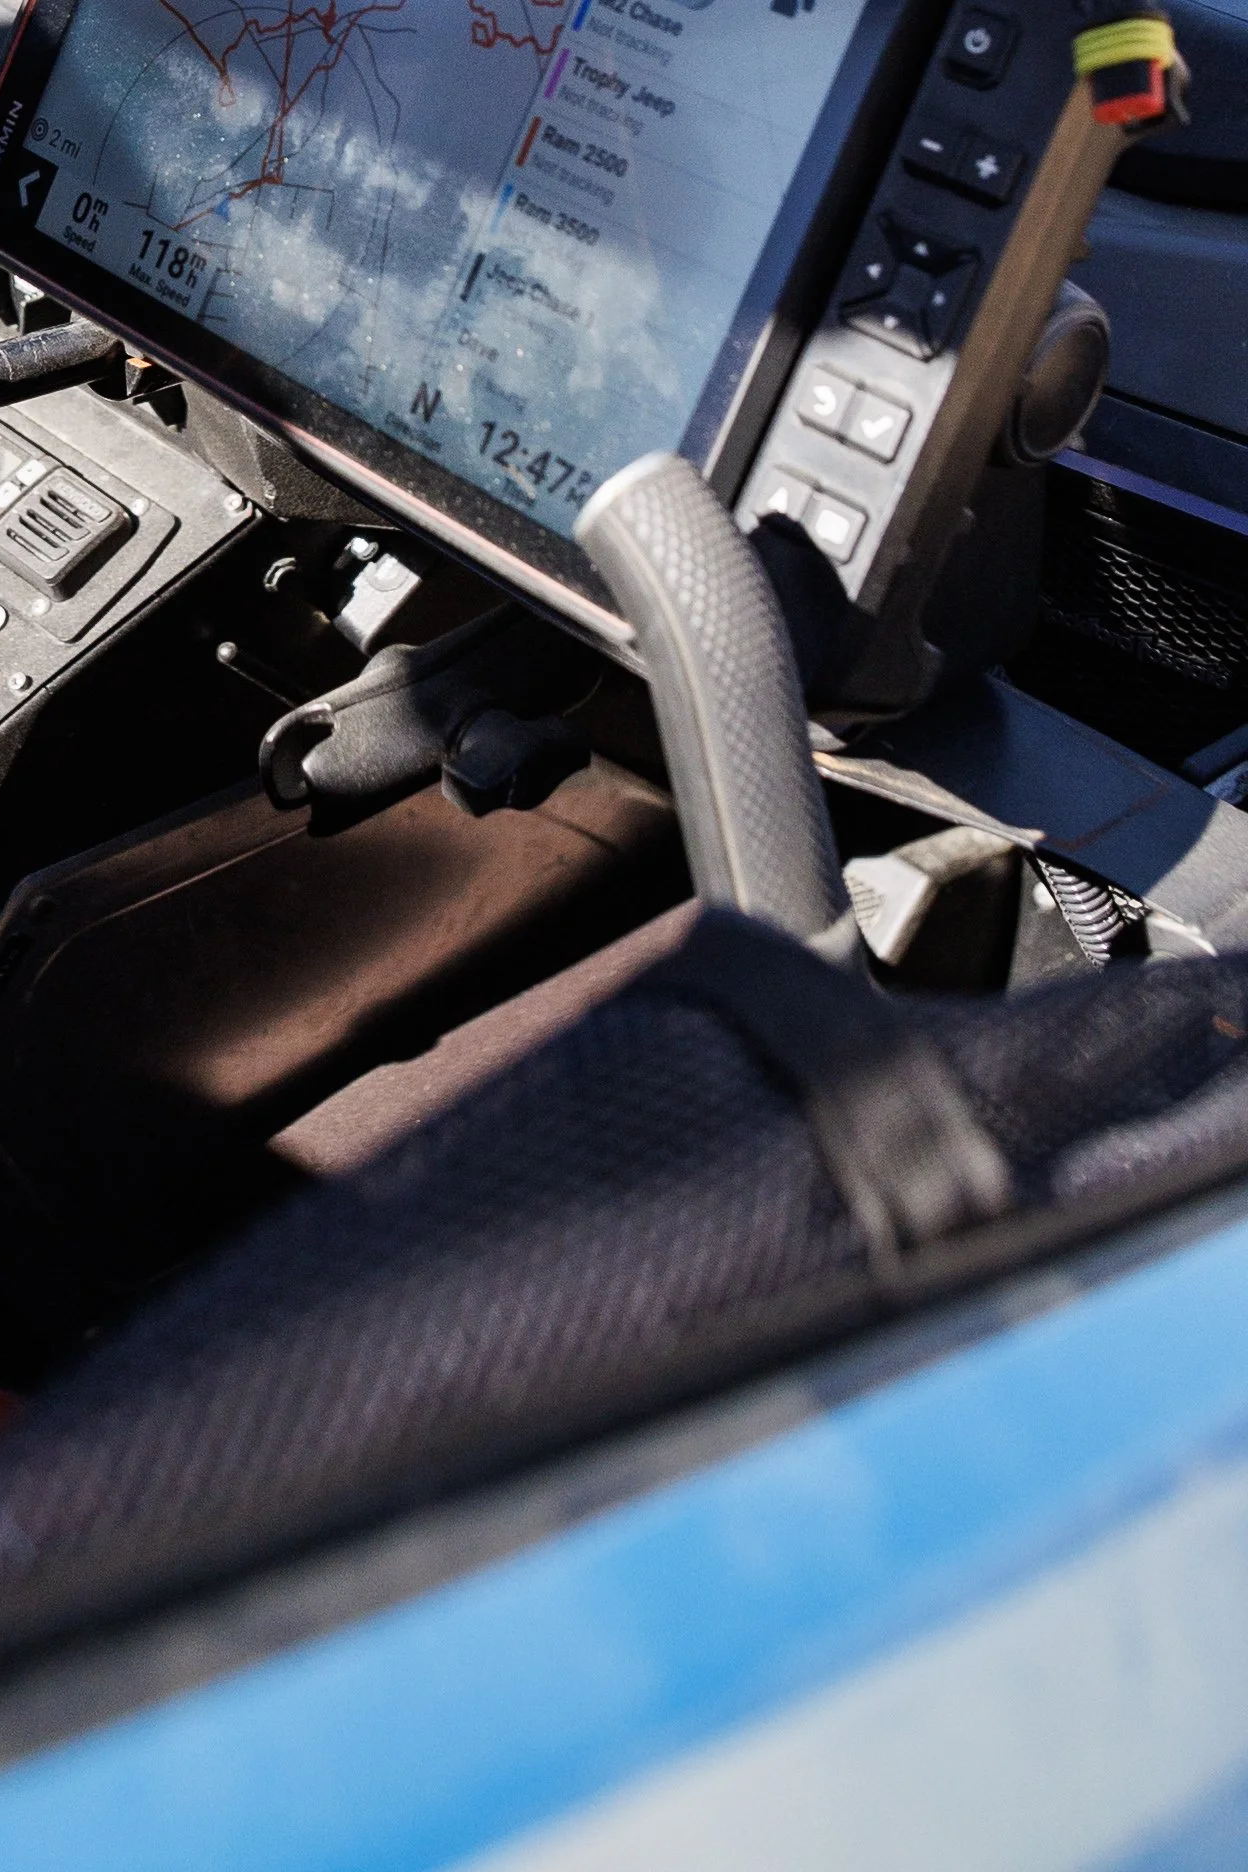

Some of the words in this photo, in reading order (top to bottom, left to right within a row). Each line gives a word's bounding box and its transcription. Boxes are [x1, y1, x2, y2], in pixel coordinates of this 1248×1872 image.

[630, 0, 684, 36] Chase
[572, 55, 631, 100] Trophy
[632, 86, 676, 119] Jeep
[49, 128, 61, 148] 2
[61, 138, 83, 159] mi
[541, 124, 581, 157] Ram
[582, 143, 629, 177] 2500
[72, 192, 92, 223] 0
[514, 192, 553, 225] Ram
[555, 212, 600, 246] 3500
[62, 225, 97, 253] Speed
[139, 229, 189, 279] 118
[155, 279, 192, 307] Speed
[409, 381, 442, 424] N
[479, 420, 577, 495] 12:47
